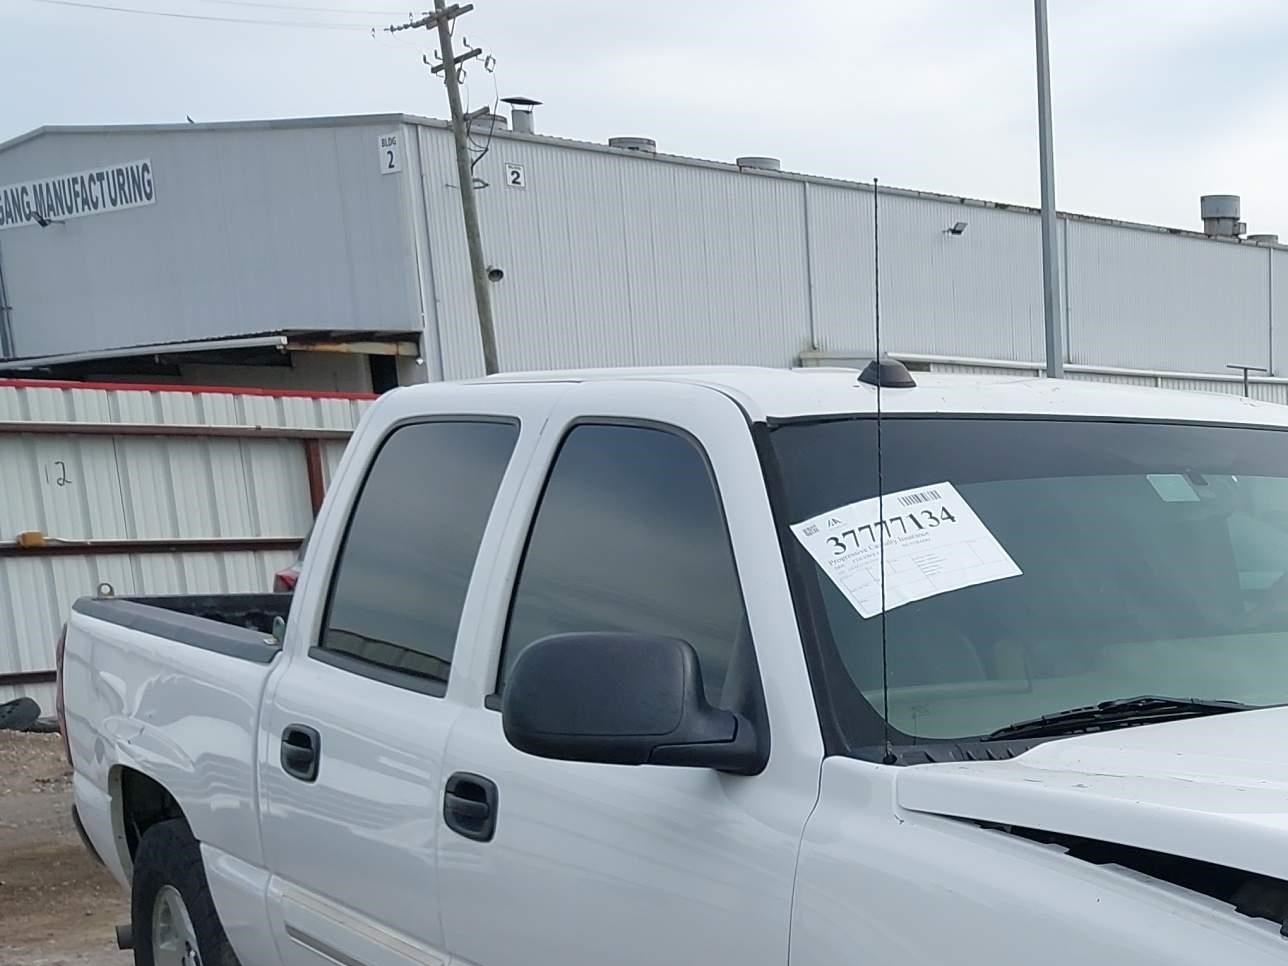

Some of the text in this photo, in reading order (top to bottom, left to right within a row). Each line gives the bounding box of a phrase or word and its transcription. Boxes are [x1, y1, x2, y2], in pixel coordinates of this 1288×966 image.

[381, 136, 397, 147] BLDG
[387, 150, 395, 169] 2
[511, 170, 521, 185] 2
[33, 162, 153, 218] MANUFACTURING
[826, 505, 957, 556] 37777134
